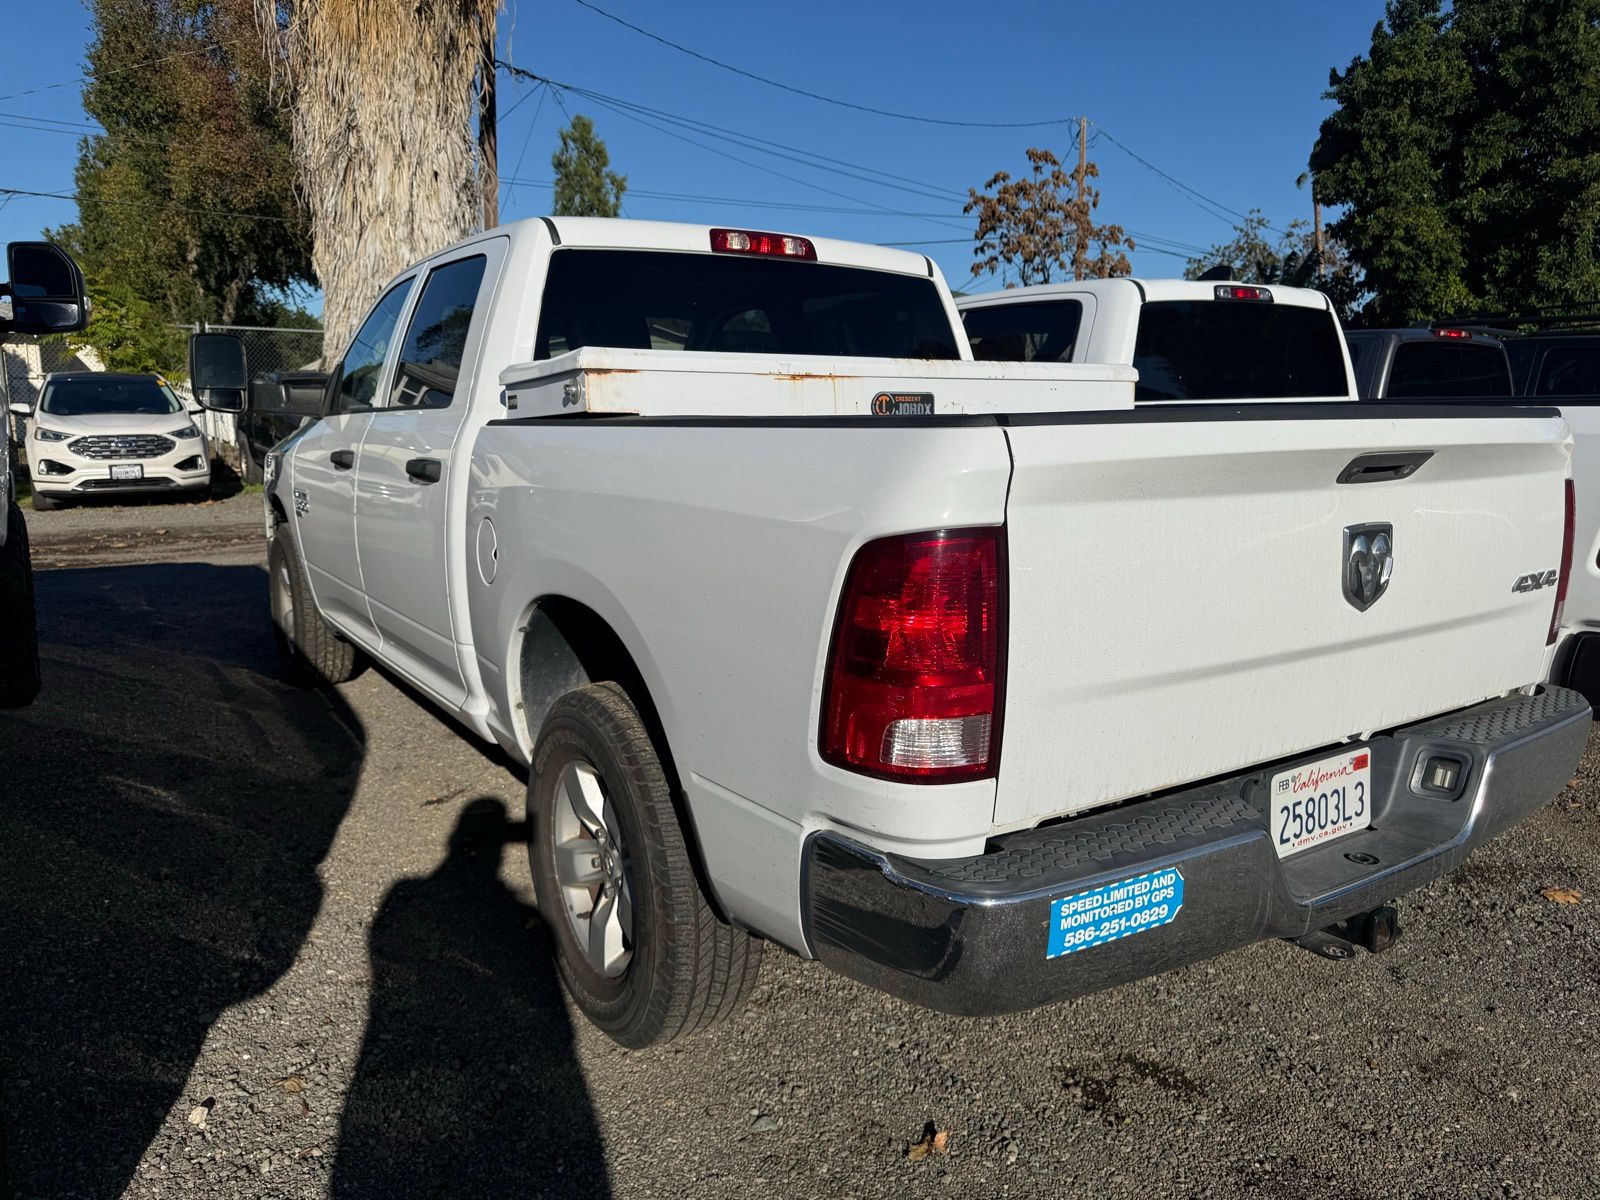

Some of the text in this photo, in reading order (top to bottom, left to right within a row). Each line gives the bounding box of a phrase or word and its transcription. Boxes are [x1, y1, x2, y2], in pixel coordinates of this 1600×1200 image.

[896, 403, 931, 415] JOBOX
[1278, 763, 1353, 793] FEB California
[1280, 781, 1365, 845] 25803L3
[1297, 823, 1348, 846] dmv.ca.gov
[1061, 873, 1176, 916] SPEED LIMITED AND
[1061, 887, 1175, 930] MONITORED BY GPS
[1064, 904, 1169, 947] 586-251-0829
